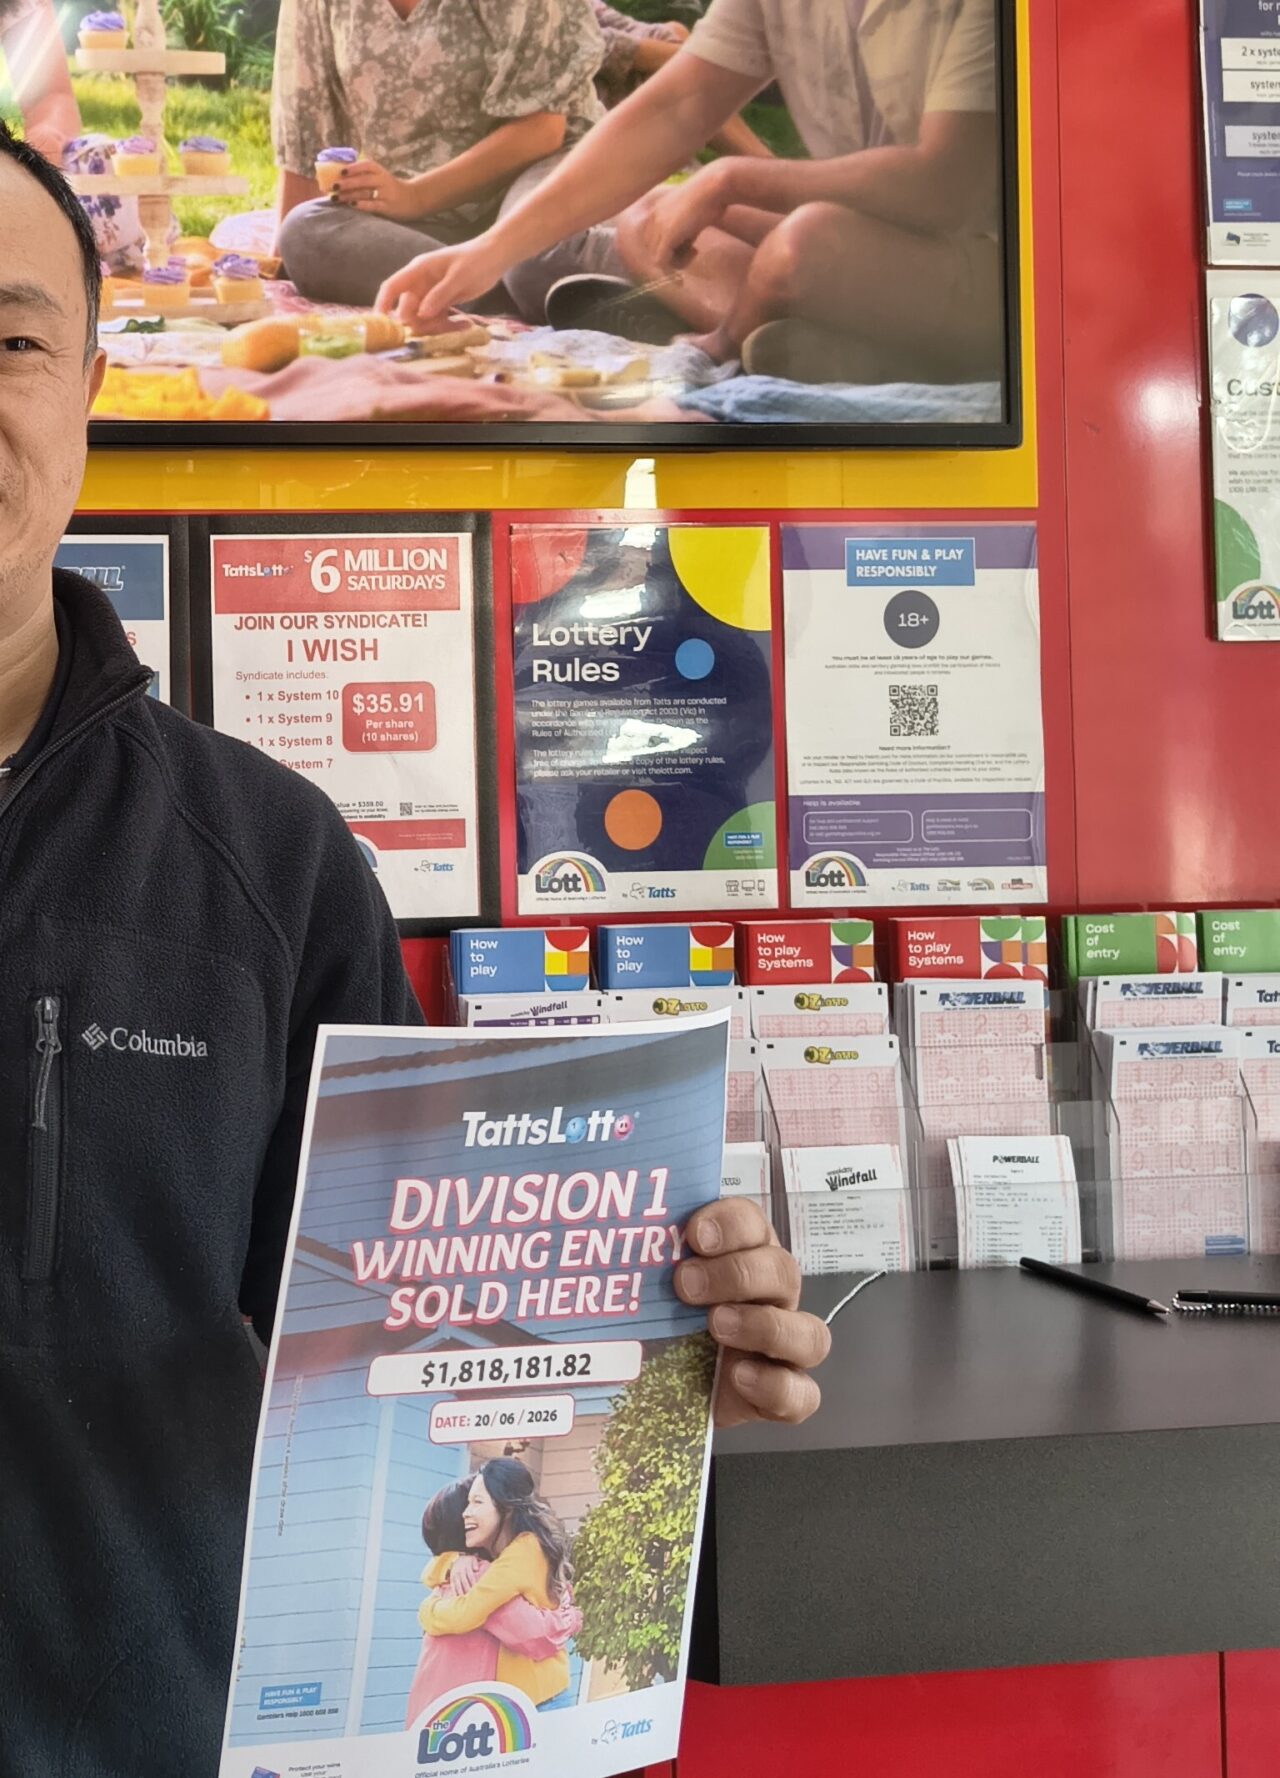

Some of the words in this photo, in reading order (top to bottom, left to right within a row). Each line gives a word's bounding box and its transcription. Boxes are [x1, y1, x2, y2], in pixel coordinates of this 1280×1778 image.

[343, 548, 448, 572] MILLION
[855, 549, 888, 561] HAVE
[892, 549, 918, 561] FUN
[921, 549, 931, 560] &
[934, 549, 964, 561] PLAY
[856, 565, 937, 578] RESPONSIBLY
[346, 575, 446, 591] SATURDAYS
[1232, 601, 1275, 619] Lott
[234, 615, 275, 631] JOIN
[279, 614, 319, 630] OUR
[323, 613, 428, 630] SYNDICATE!
[898, 613, 929, 628] 18+
[532, 623, 652, 652] Lottery
[286, 640, 294, 662] I
[303, 638, 379, 662] WISH
[235, 671, 284, 682] Syndicate
[532, 657, 620, 683] Rules
[257, 691, 263, 701] 1
[277, 691, 322, 703] System
[325, 690, 339, 700] 10
[352, 693, 425, 715] $35.91
[257, 714, 263, 724] 1
[277, 713, 322, 726] System
[325, 713, 333, 723] 9
[365, 719, 384, 729] Per
[385, 719, 414, 729] share
[258, 737, 264, 746] 1
[278, 736, 322, 749] System
[326, 736, 333, 746] 8
[361, 732, 378, 743] (10
[380, 731, 419, 743] shares)
[326, 758, 334, 768] 7
[535, 873, 582, 894] Lott
[648, 886, 677, 899] Tatts
[805, 870, 846, 888] Lott
[1085, 923, 1115, 935] Cost
[1211, 920, 1241, 931] Cost
[616, 935, 644, 946] How
[757, 933, 785, 943] How
[907, 930, 935, 941] How
[1086, 936, 1099, 946] of
[1212, 933, 1226, 943] of
[470, 939, 498, 950] How
[758, 945, 771, 955] to
[774, 944, 801, 958] play
[908, 943, 922, 953] to
[925, 942, 951, 955] play
[1213, 945, 1247, 957] entry
[470, 953, 484, 963] to
[616, 949, 630, 959] to
[908, 954, 964, 968] Systems
[1086, 948, 1120, 960] entry
[470, 965, 497, 977] play
[616, 960, 643, 973] play
[758, 957, 814, 971] Systems
[1121, 982, 1204, 996] POWERBALL
[938, 991, 1026, 1006] POWERBALL
[530, 1000, 568, 1017] Windfall
[110, 1027, 208, 1057] Columbia
[1137, 1041, 1223, 1056] POWERBALL
[462, 1106, 635, 1147] TattsLotto
[992, 1155, 1040, 1164] POWERBALL
[825, 1168, 878, 1192] Windfall
[389, 1169, 638, 1232] DIVISION
[641, 1166, 670, 1219] 1
[352, 1230, 552, 1282] WINNING
[558, 1225, 686, 1268] ENTRY
[384, 1281, 509, 1329] SOLD
[517, 1271, 643, 1319] HERE!
[420, 1353, 592, 1389] $1,818,181.82
[434, 1414, 471, 1429] DATE:
[433, 1719, 449, 1731] the
[621, 1718, 653, 1739] Tatts
[417, 1721, 495, 1765] Lott
